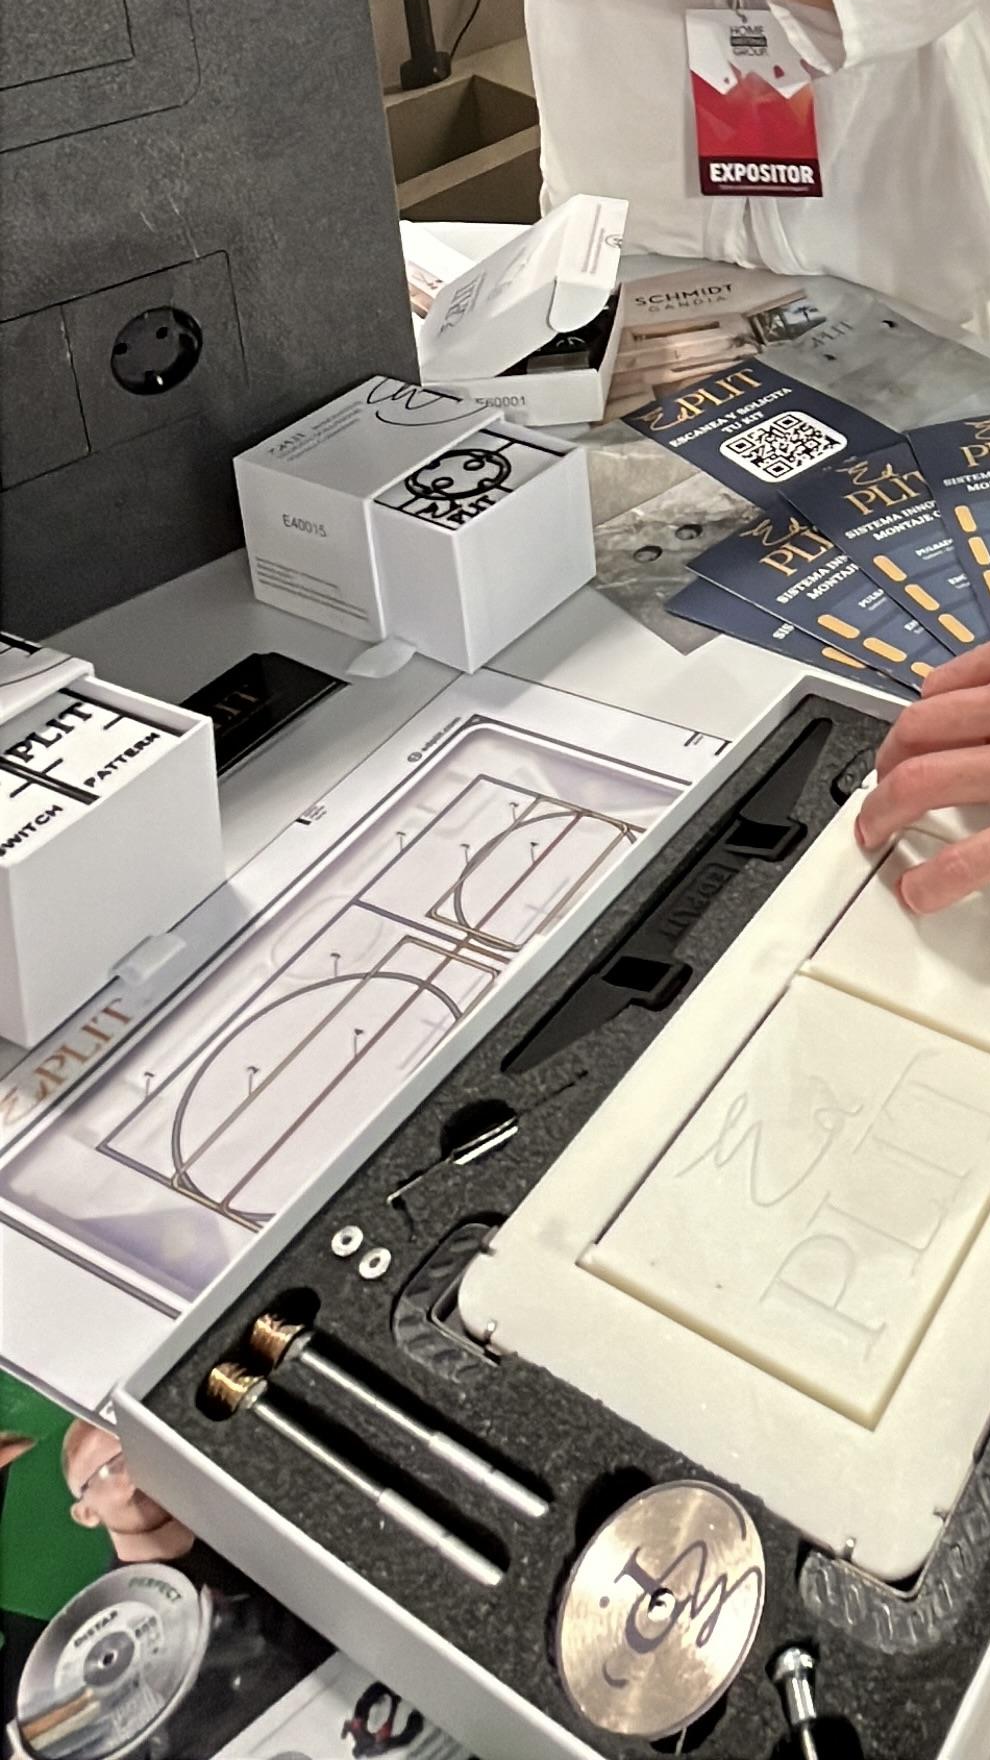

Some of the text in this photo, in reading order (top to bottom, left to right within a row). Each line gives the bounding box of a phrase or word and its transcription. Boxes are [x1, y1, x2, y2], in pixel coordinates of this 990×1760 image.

[709, 162, 815, 185] EXPOSITOR
[635, 283, 733, 307] SCHMIDT
[648, 294, 728, 313] GANDIA
[669, 387, 793, 448] ESCANEA Y SOLICITA
[721, 412, 765, 434] TU KIT
[282, 514, 328, 538] E40015
[845, 511, 902, 540] SISTEMA
[873, 513, 934, 541] MONTAJE
[759, 526, 835, 577] PLI
[776, 568, 828, 604] SISTEMA
[806, 563, 860, 600] MONTAJ
[3, 701, 93, 763] PLIT
[83, 732, 161, 788] PATTERN
